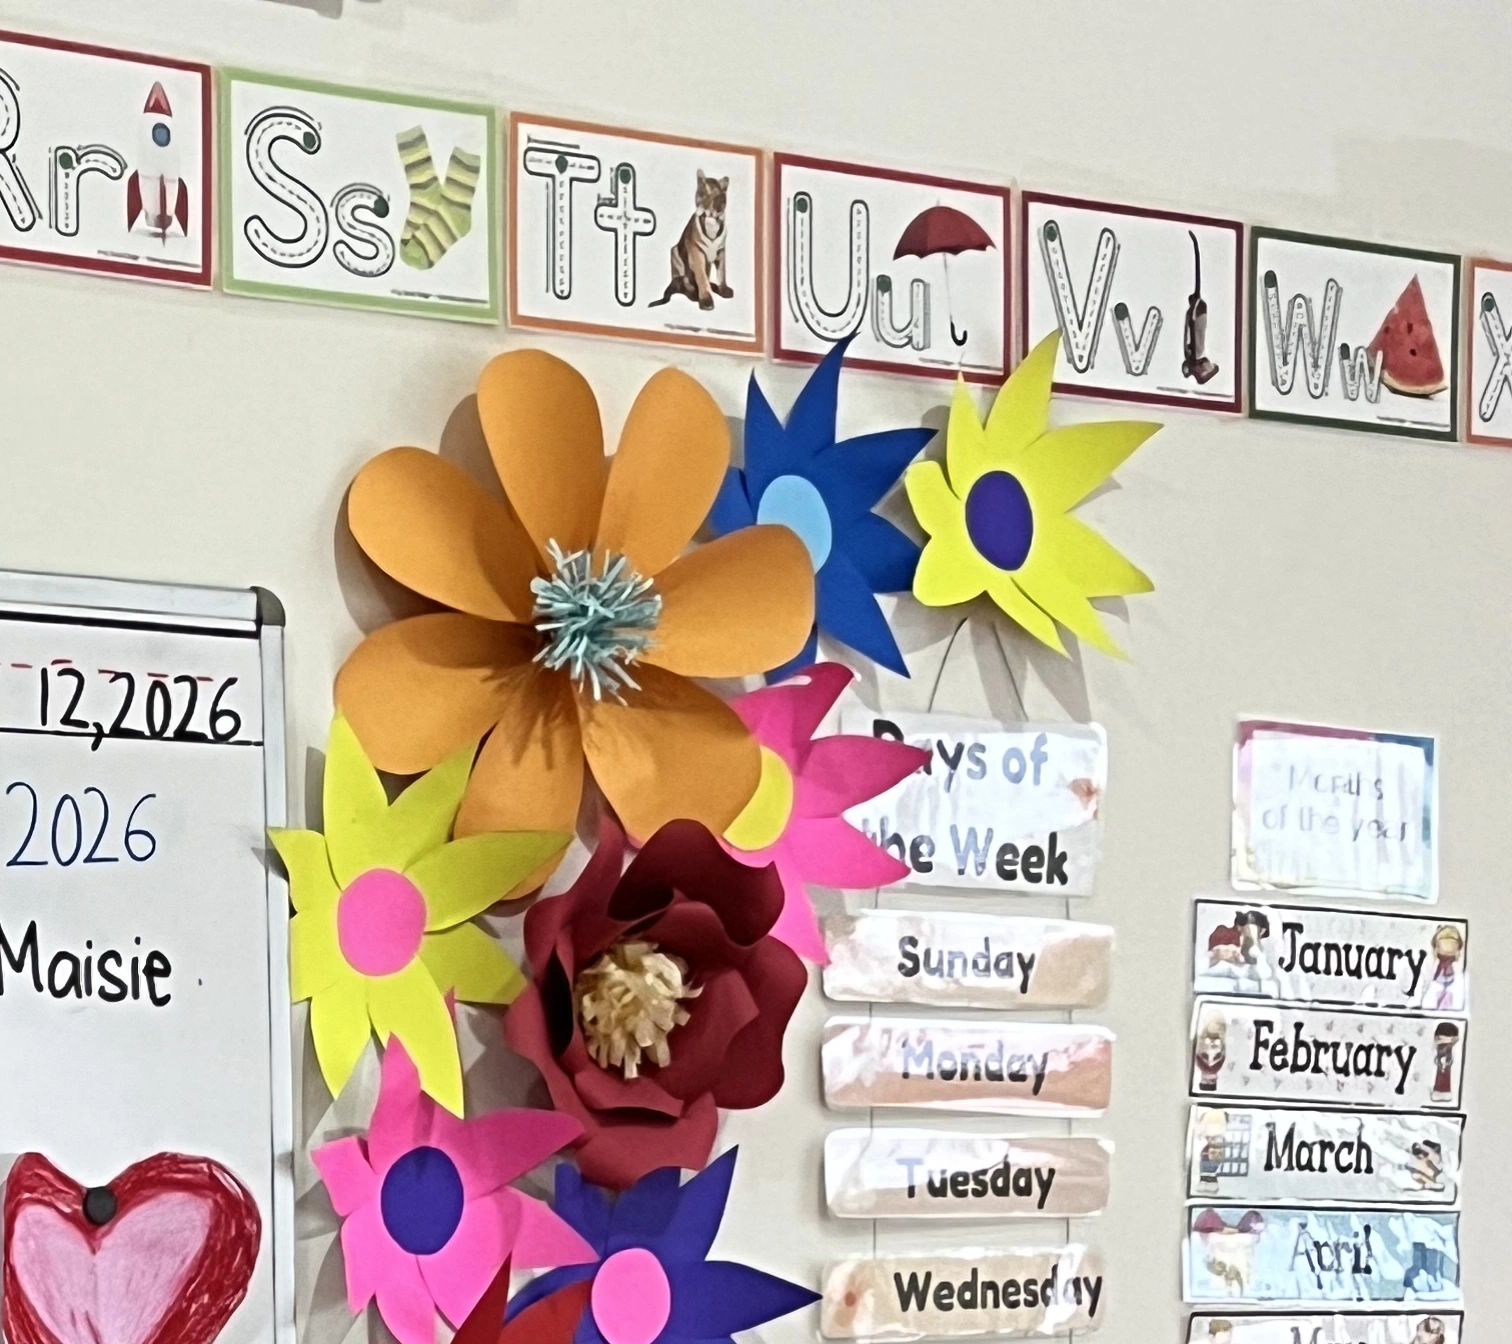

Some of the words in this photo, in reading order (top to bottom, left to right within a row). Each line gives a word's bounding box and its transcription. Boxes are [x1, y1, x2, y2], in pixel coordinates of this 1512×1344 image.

[1001, 733, 1049, 786] of
[5, 781, 158, 867] 2026
[949, 823, 1069, 886] Week
[897, 936, 1036, 994] Sunday
[1278, 922, 1428, 997] January
[901, 1038, 1049, 1096] Monday
[1249, 1019, 1417, 1095] February
[1263, 1117, 1374, 1174] March
[896, 1154, 1056, 1210] Tuesday
[893, 1263, 1103, 1319] Wednesday
